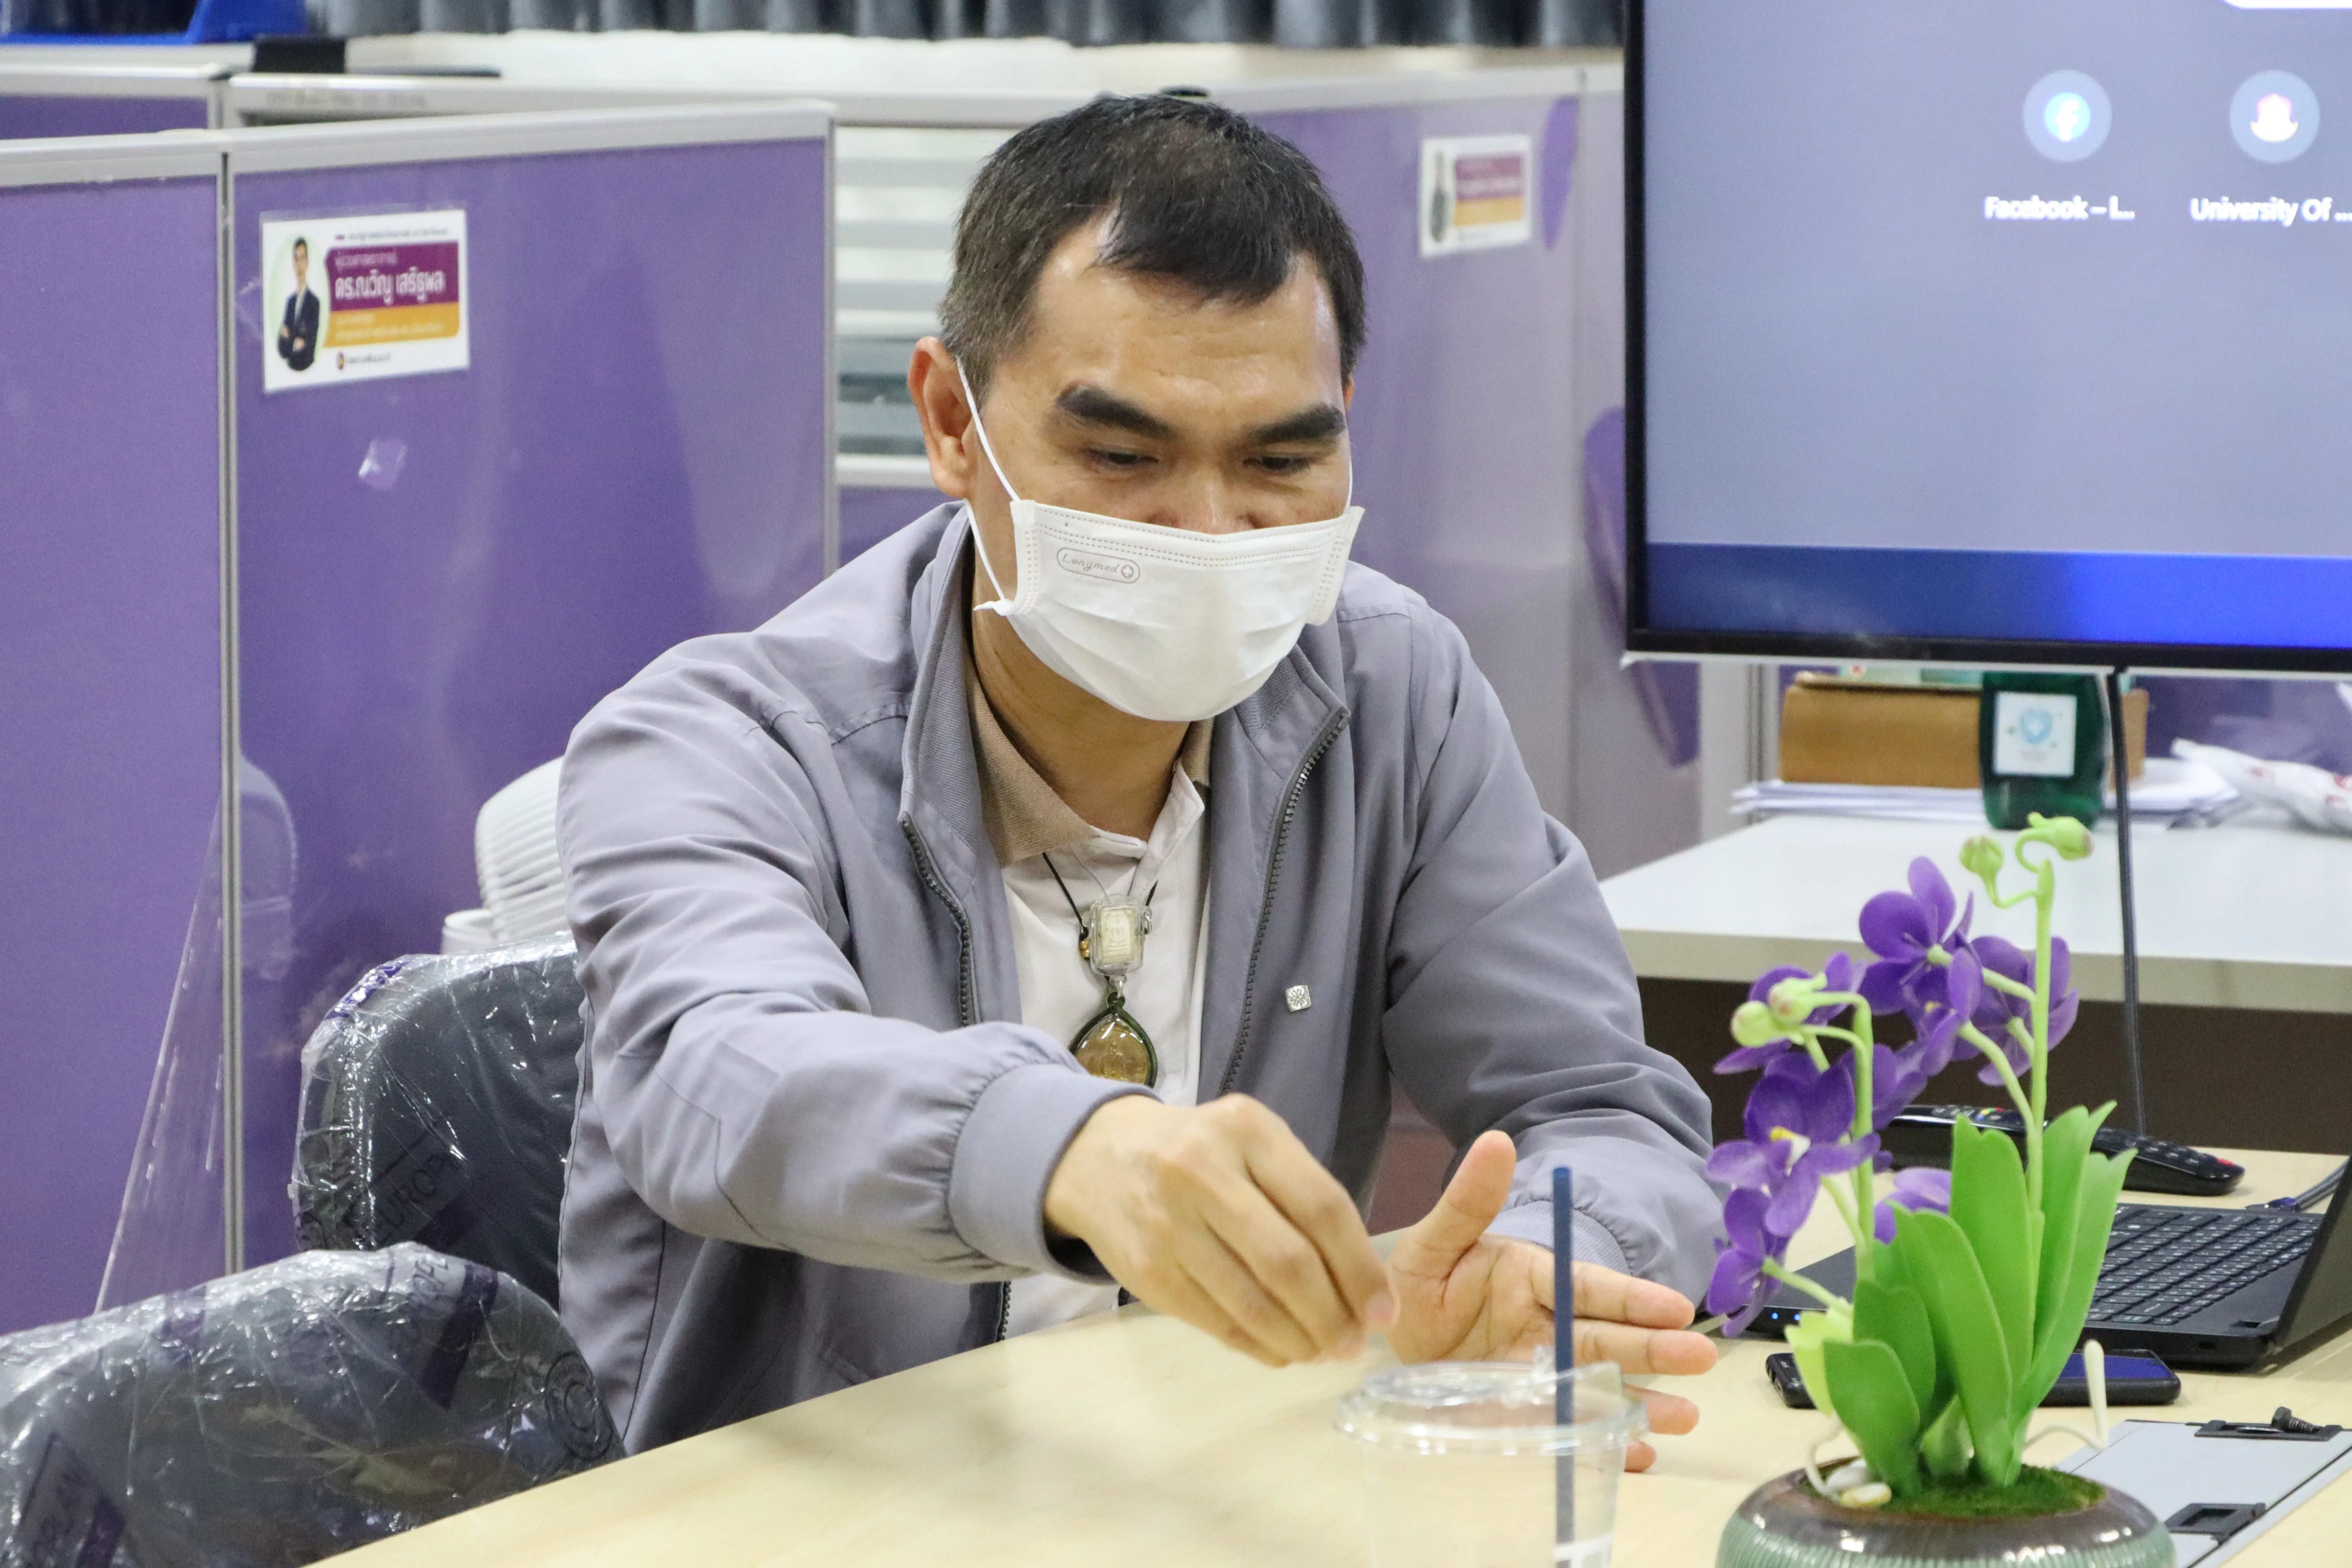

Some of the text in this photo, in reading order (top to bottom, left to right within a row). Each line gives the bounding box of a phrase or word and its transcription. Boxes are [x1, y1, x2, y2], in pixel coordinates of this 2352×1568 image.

[1984, 195, 2089, 221] Facebook
[2189, 196, 2299, 228] University
[2301, 197, 2333, 222] Of
